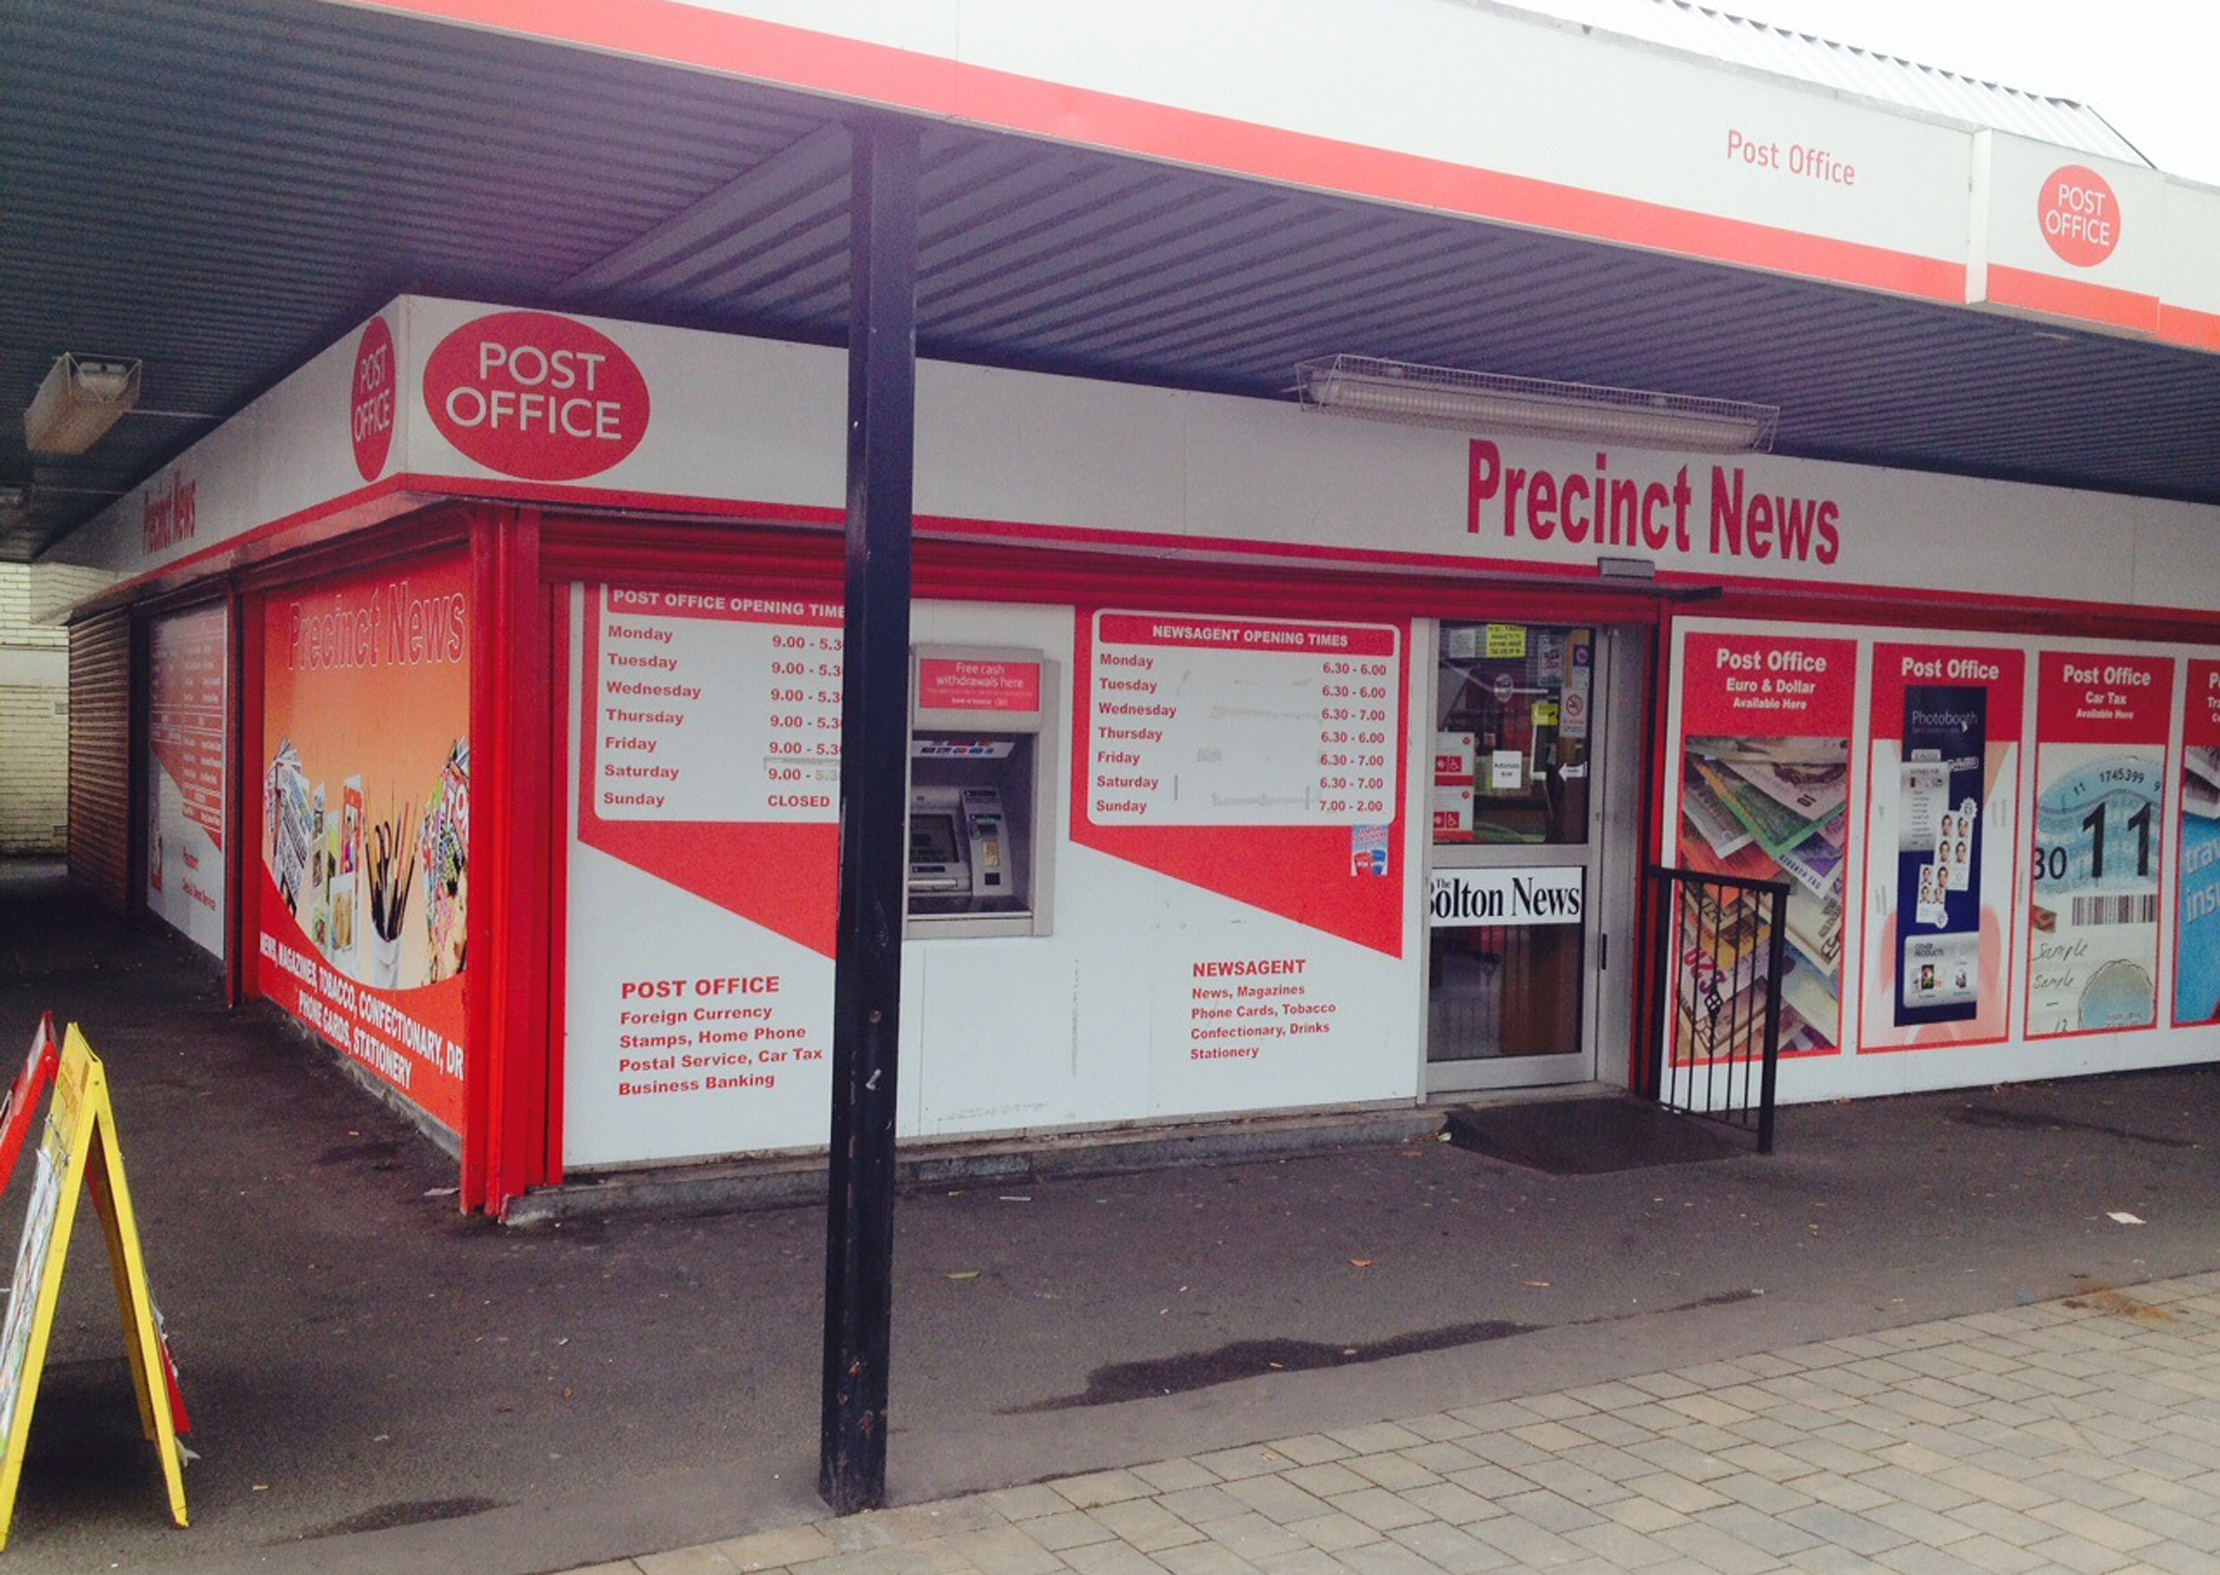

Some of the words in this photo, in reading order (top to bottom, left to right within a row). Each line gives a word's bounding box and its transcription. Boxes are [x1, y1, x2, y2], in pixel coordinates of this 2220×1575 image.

[1726, 129, 1779, 169] Post
[1788, 144, 1856, 187] Office
[2058, 183, 2107, 216] POST
[2046, 210, 2110, 247] OFFICE
[360, 344, 387, 395] POST
[480, 341, 606, 391] POST
[354, 389, 390, 442] OFFICE
[445, 386, 622, 440] OFFICE
[1467, 438, 1692, 553] Precinct
[1709, 465, 1840, 565] News
[613, 589, 659, 605] POST
[665, 593, 725, 610] OFFICE
[730, 598, 804, 615] OPENING
[808, 604, 845, 618] TIME
[288, 587, 380, 671] Precinct
[387, 581, 466, 665] News
[1153, 625, 1239, 642] NEWSAGENT
[1244, 630, 1304, 645] OPENING
[1308, 634, 1348, 647] TIMES
[608, 625, 673, 643] Monday
[772, 635, 805, 648] 9.00
[819, 638, 843, 651] 5.3
[607, 653, 678, 671] Tuesday
[771, 661, 804, 675] 9.00
[818, 664, 843, 677] 5.3
[955, 662, 979, 674] Free
[981, 664, 1005, 675] cash
[1101, 654, 1154, 669] Monday
[1323, 662, 1349, 675] 6.30
[1361, 663, 1387, 676] 6.00
[1716, 648, 1761, 671] Post
[1767, 650, 1827, 673] Office
[1901, 657, 1942, 677] Post
[1947, 658, 1999, 680] Office
[936, 675, 998, 688] withdrawals
[1000, 676, 1024, 689] here
[2063, 664, 2099, 684] Post
[2104, 666, 2151, 685] Office
[606, 681, 701, 700] Wednesday
[771, 688, 804, 701] 9.00
[818, 691, 843, 703] 5.3
[1100, 678, 1157, 694] Tuesday
[1322, 685, 1349, 698] 6.30
[1360, 687, 1386, 699] 6.00
[1726, 677, 1758, 693] Euro
[1761, 679, 1772, 693] &
[1775, 679, 1816, 694] Dollar
[1733, 697, 1780, 710] Available
[1782, 698, 1807, 710] Here
[2085, 691, 2104, 704] Car
[2107, 692, 2127, 705] Tax
[606, 708, 684, 726] Thursday
[770, 715, 803, 727] 9.00
[817, 717, 842, 729] 5.3
[1099, 702, 1177, 718] Wednesday
[1321, 708, 1348, 721] 6.30
[1360, 709, 1386, 722] 7.00
[1912, 710, 1978, 726] Photobooth
[2076, 708, 2113, 719] Available
[605, 736, 657, 753] Friday
[769, 742, 802, 753] 9.00
[816, 743, 842, 755] 5.3
[1098, 727, 1163, 742] Thursday
[1321, 731, 1348, 744] 6.30
[1359, 732, 1385, 744] 6.00
[1098, 751, 1141, 766] Friday
[1320, 754, 1347, 767] 6.30
[1358, 755, 1385, 767] 7.00
[604, 764, 679, 780] Saturday
[768, 768, 801, 780] 9.00
[1097, 775, 1159, 790] Saturday
[1320, 777, 1347, 790] 6.30
[1358, 777, 1384, 790] 7.00
[603, 792, 665, 807] Sunday
[768, 795, 830, 807] CLOSED
[1097, 800, 1147, 814] Sunday
[1320, 800, 1346, 812] 7.00
[1357, 800, 1383, 812] 2.00
[2082, 801, 2151, 878] 11
[1437, 879, 1451, 889] The
[1431, 878, 1503, 918] olton
[1512, 877, 1579, 916] News
[1193, 959, 1306, 977] NEWSAGENT
[622, 980, 687, 999] POST
[695, 976, 780, 996] OFFICE
[1192, 988, 1233, 999] News,
[1238, 984, 1305, 999] Magazines
[319, 965, 358, 1019] TOBACCO,
[359, 991, 444, 1075] CONFECTIONARY,
[620, 1010, 688, 1026] Foreign
[693, 1006, 773, 1021] Currency
[1192, 1007, 1232, 1019] Phone
[1236, 1005, 1279, 1017] Cards,
[1283, 1003, 1336, 1015] Tobacco
[620, 1033, 693, 1049] Stamps,
[698, 1029, 748, 1044] Home
[754, 1027, 806, 1041] Phone
[1191, 1025, 1286, 1040] Confectionary,
[1290, 1022, 1330, 1035] Drinks
[354, 1026, 412, 1089] STATIONERY
[619, 1056, 676, 1072] Postal
[681, 1053, 753, 1069] Service,
[758, 1050, 788, 1063] Car
[792, 1047, 823, 1061] Tax
[1191, 1047, 1260, 1060] Stationery
[619, 1080, 700, 1095] Business
[705, 1073, 775, 1089] Banking
